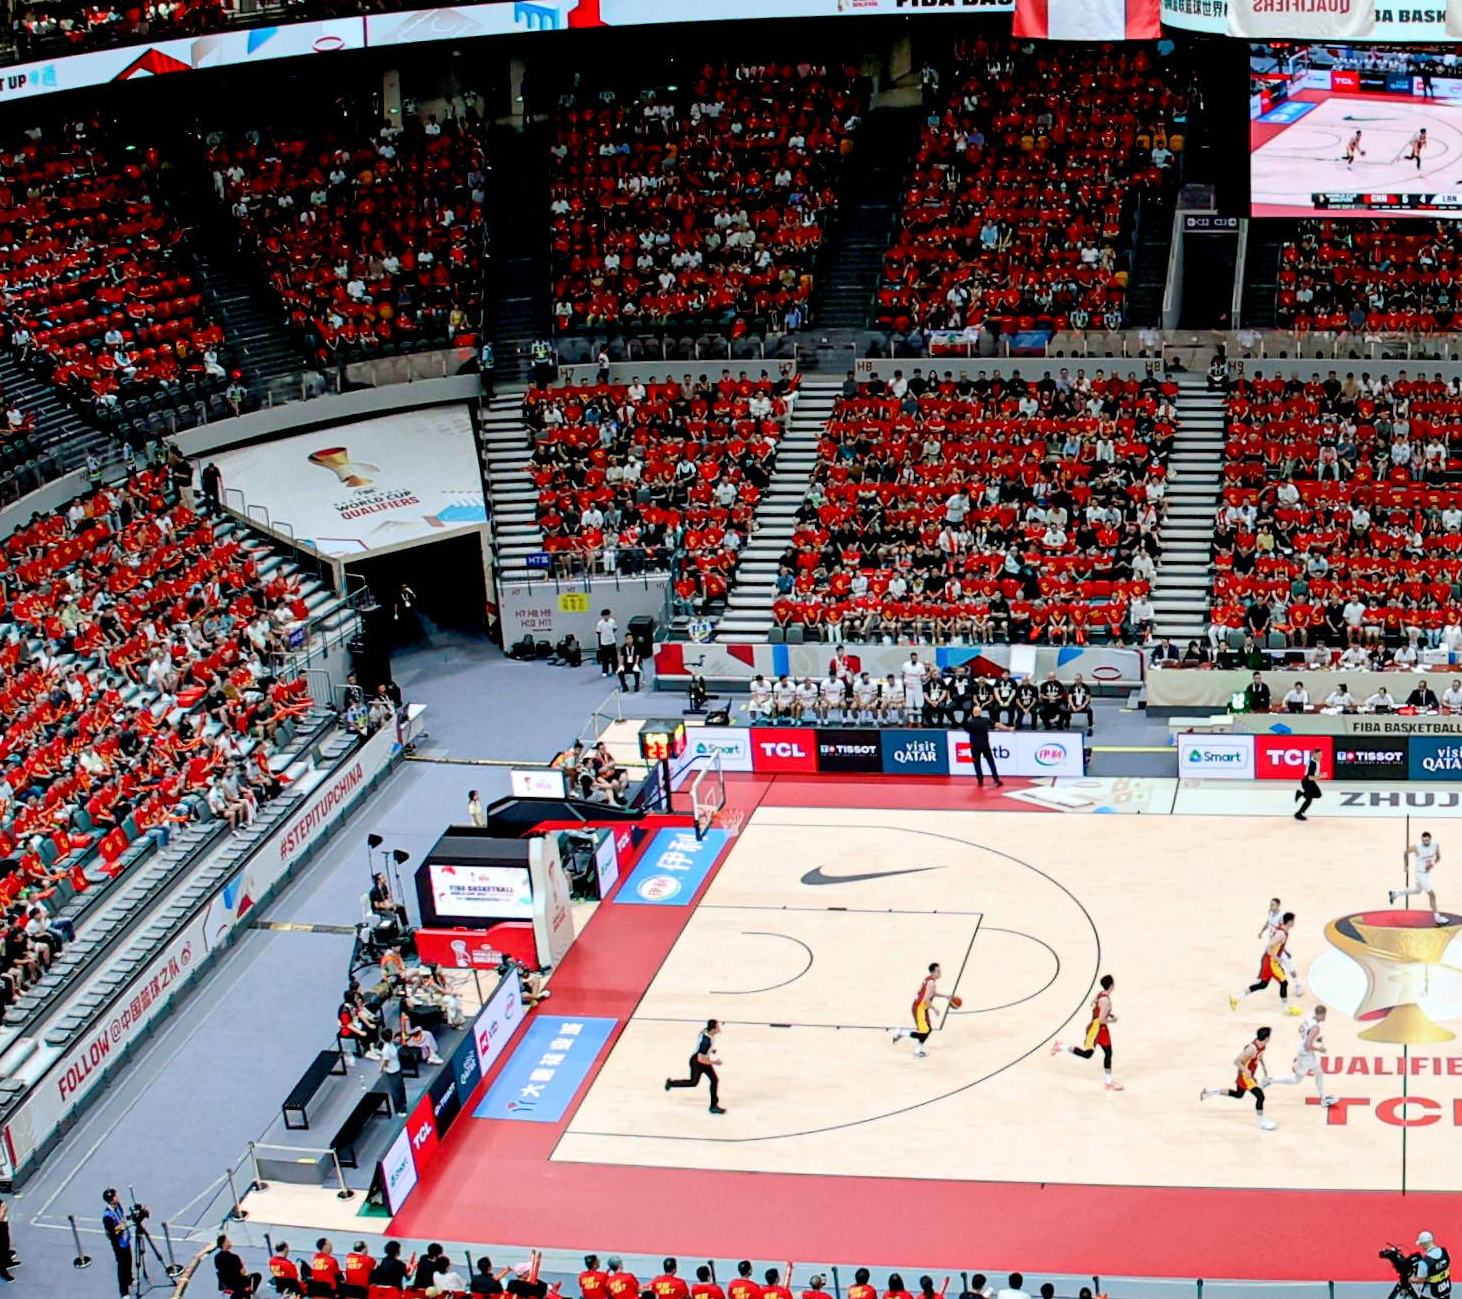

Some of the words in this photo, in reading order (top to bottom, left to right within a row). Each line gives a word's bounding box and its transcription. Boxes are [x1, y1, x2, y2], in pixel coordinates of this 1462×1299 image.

[7, 74, 27, 92] UP
[1335, 77, 1354, 85] TCL
[560, 366, 575, 379] H7
[857, 361, 873, 372] H8
[1145, 361, 1160, 372] H8
[1228, 361, 1244, 372] H9
[334, 495, 384, 514] WORLD
[385, 489, 412, 505] CUP
[340, 496, 420, 520] QUALIFIERS
[1353, 722, 1381, 734] FIBA
[648, 743, 668, 759] 23
[710, 742, 741, 756] Smart
[759, 742, 806, 758] TCL
[836, 745, 877, 754] TISSOT
[906, 742, 936, 751] visit
[993, 745, 1011, 760] tb
[894, 750, 937, 764] QATAR
[1204, 749, 1241, 763] Smart
[1355, 752, 1403, 761] TISSOT
[279, 761, 364, 861] #STEPITUPCHINA
[657, 831, 709, 872] 伊利
[449, 884, 466, 892] FIBA
[468, 885, 514, 893] BASKETBALL
[57, 1029, 112, 1102] FOLLOW
[413, 1121, 432, 1149] TCL
